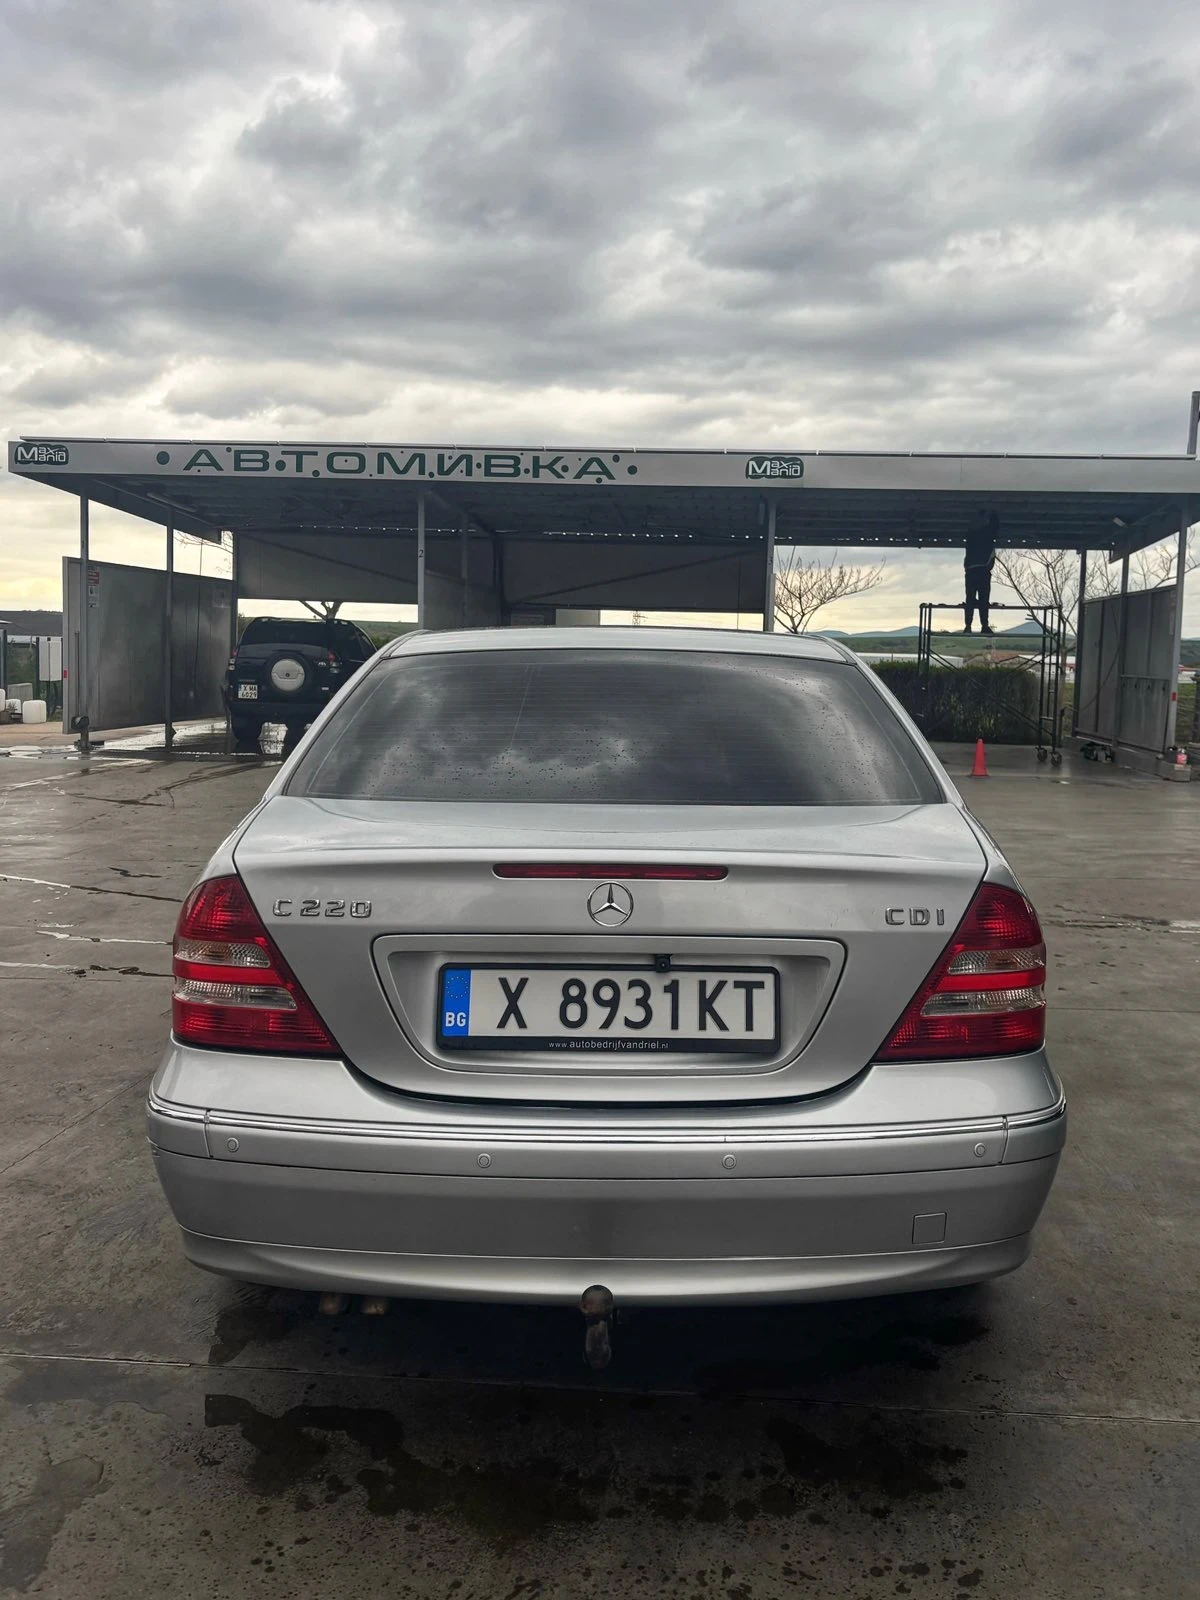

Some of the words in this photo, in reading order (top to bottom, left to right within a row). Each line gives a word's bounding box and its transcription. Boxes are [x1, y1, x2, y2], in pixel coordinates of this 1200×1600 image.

[273, 899, 293, 917] C
[300, 899, 372, 918] 220
[885, 907, 945, 926] CDI
[496, 977, 529, 1030] X
[445, 1011, 467, 1027] BG
[548, 1040, 669, 1050] www.autobedrijfvandriel.nl
